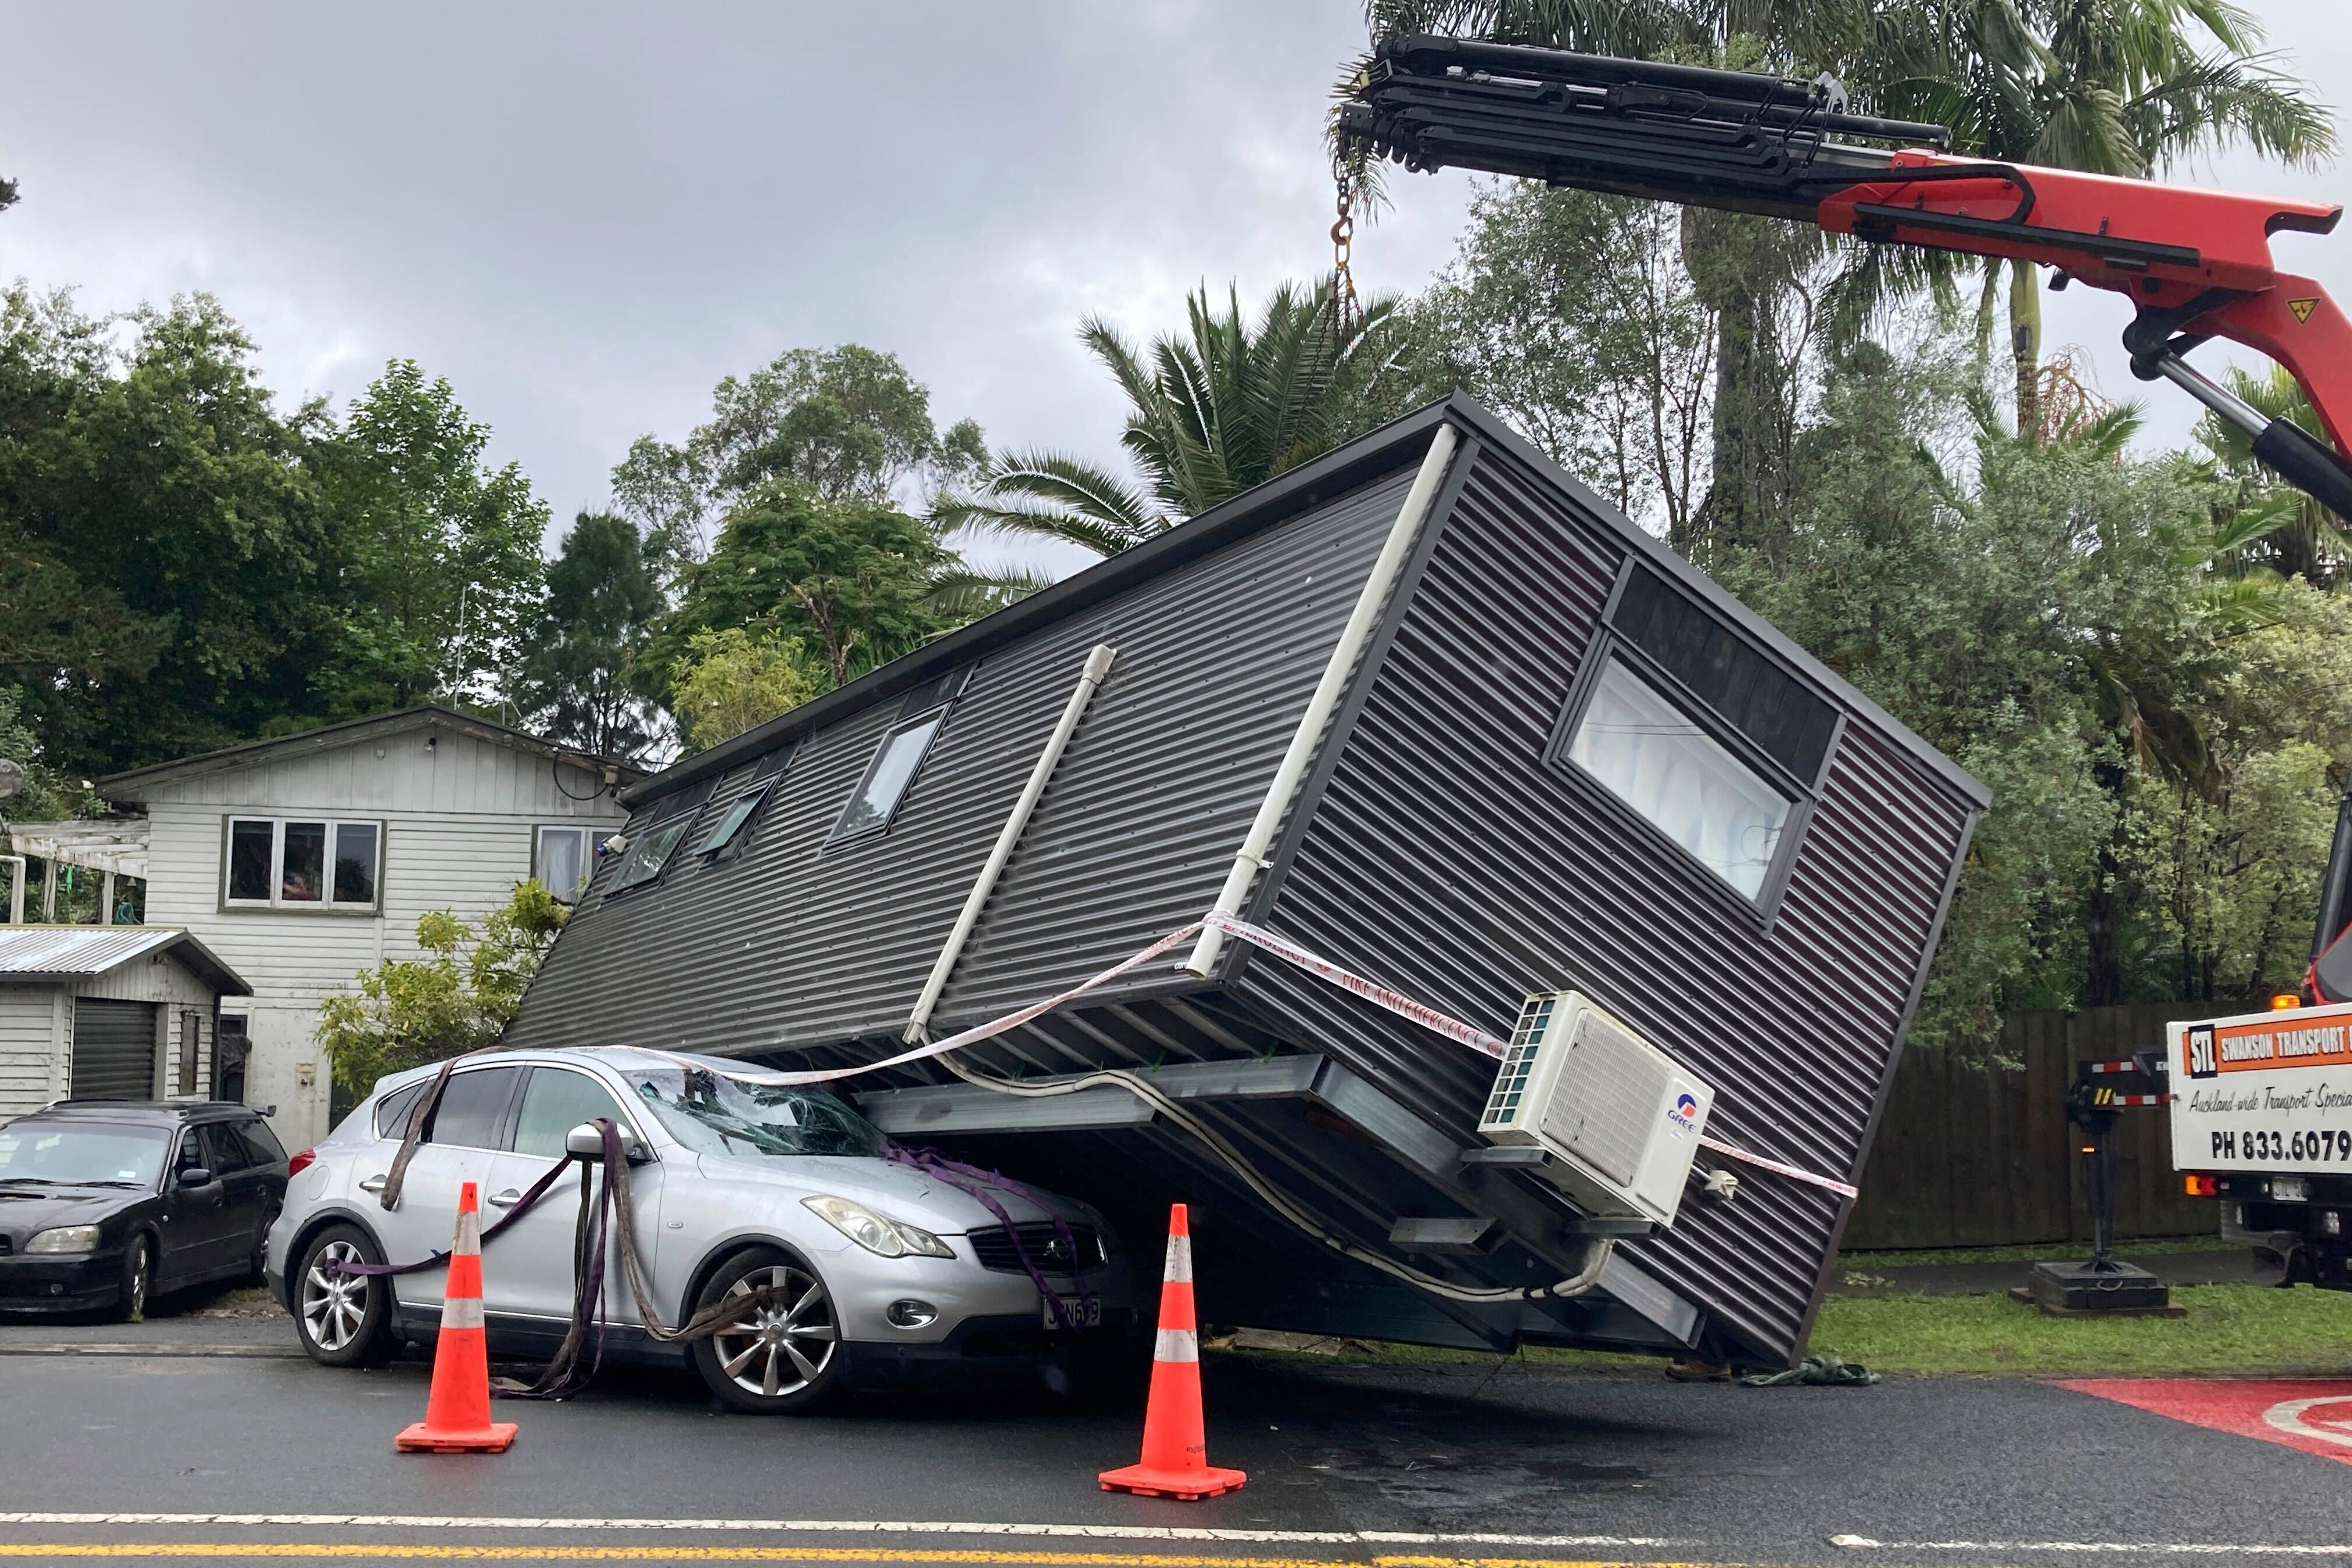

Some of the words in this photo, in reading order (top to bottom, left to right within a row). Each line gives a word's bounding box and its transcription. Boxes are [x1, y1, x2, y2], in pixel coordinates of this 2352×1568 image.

[1342, 974, 1370, 997] FIRE
[1375, 988, 1404, 1012] AND
[1405, 1002, 1484, 1048] EMERGENCY
[2190, 1031, 2216, 1073] STL
[2221, 1034, 2274, 1062] SWANSON
[2277, 1027, 2344, 1058] TRANSPORT
[2189, 1090, 2260, 1112] Auckland-wide
[2264, 1086, 2314, 1117] Transport
[1668, 1110, 1696, 1133] GREE
[2212, 1131, 2236, 1158] PH
[2243, 1130, 2351, 1161] 833.6079
[1048, 1301, 1099, 1325] JN69
